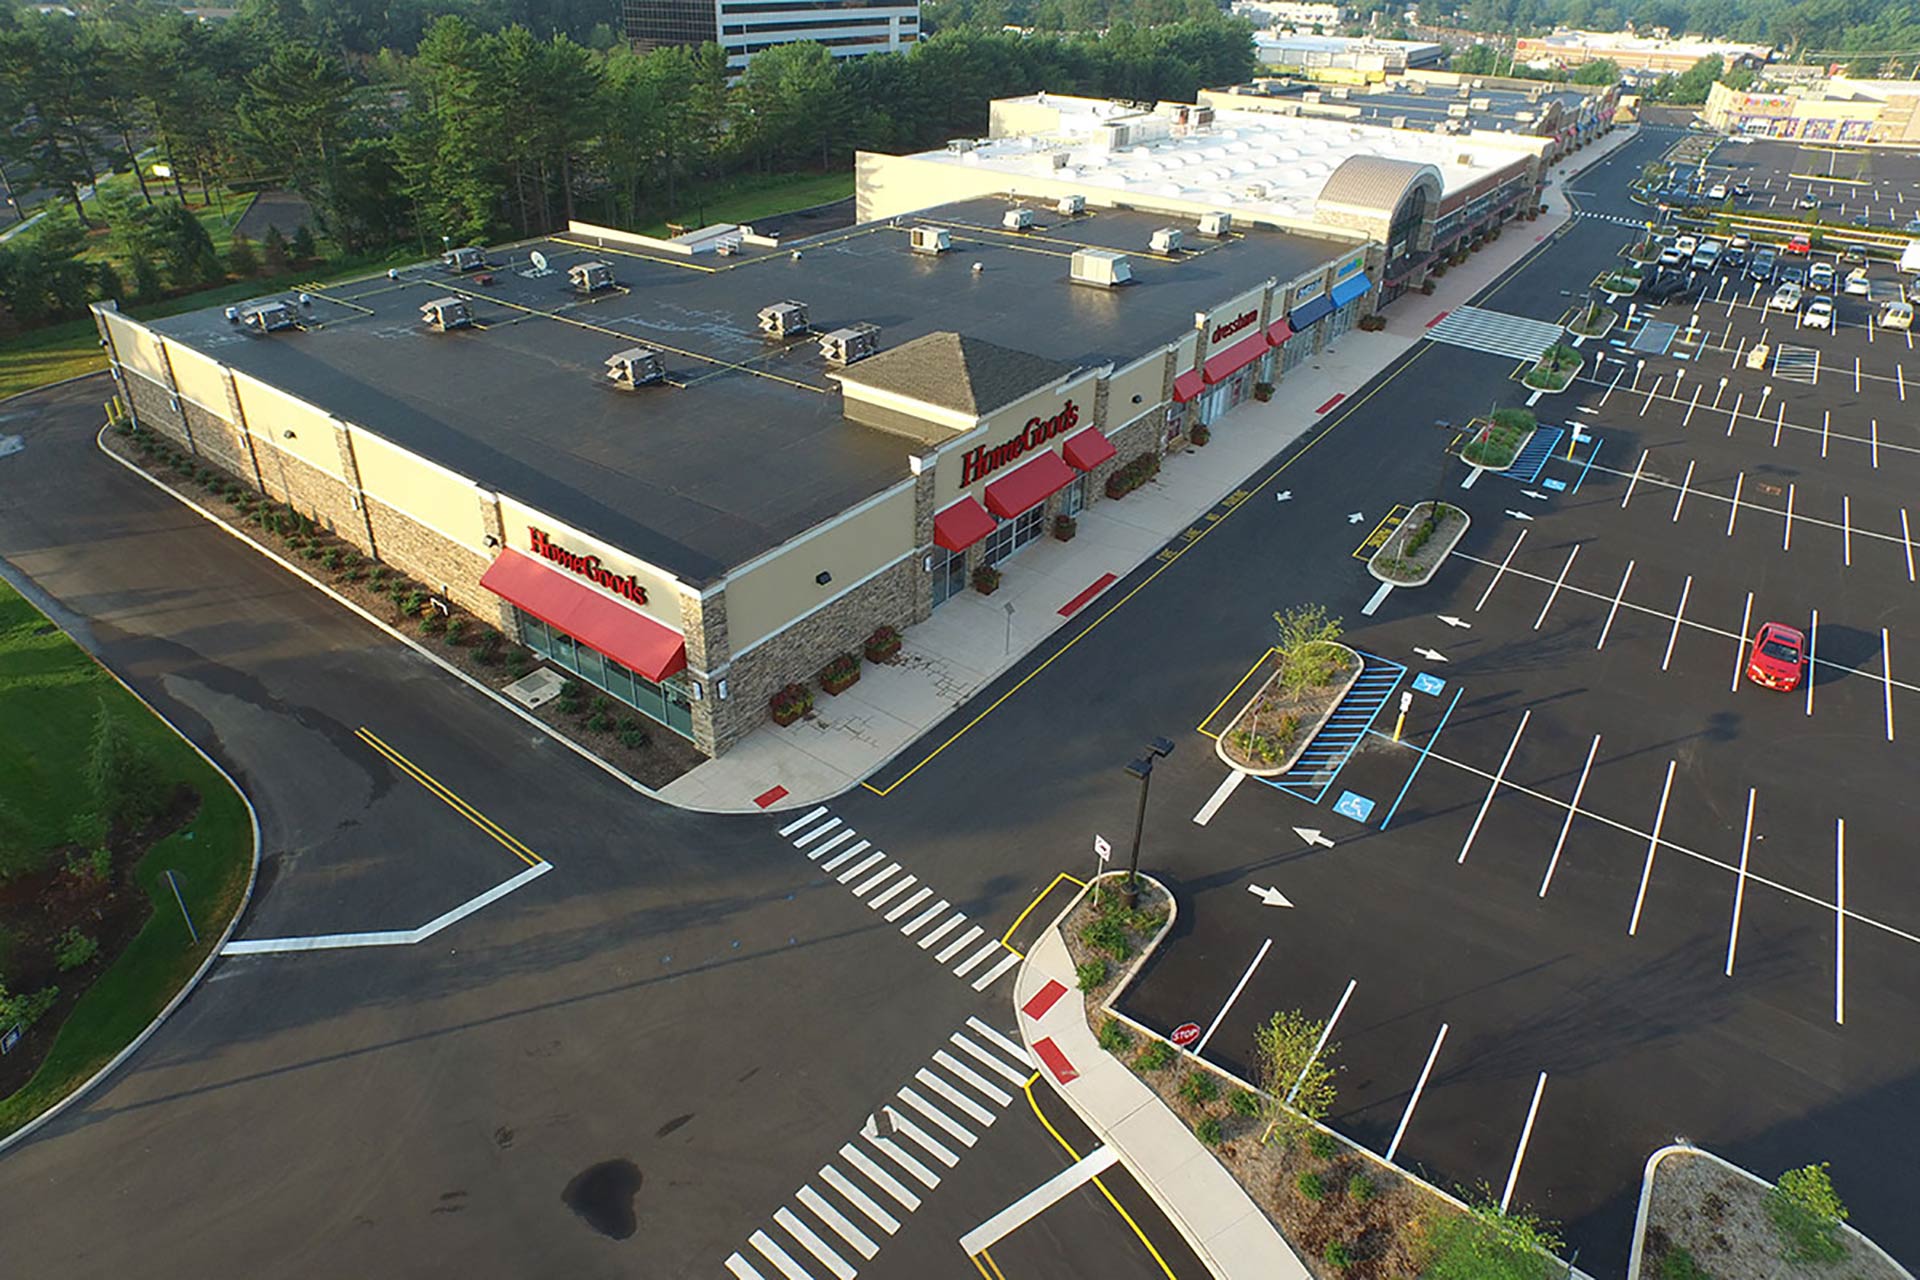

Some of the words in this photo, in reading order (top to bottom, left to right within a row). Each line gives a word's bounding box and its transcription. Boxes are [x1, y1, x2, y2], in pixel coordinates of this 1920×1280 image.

[959, 399, 1079, 488] HomeGoods
[527, 525, 648, 606] HomeGoods
[1172, 1028, 1198, 1041] STOP
